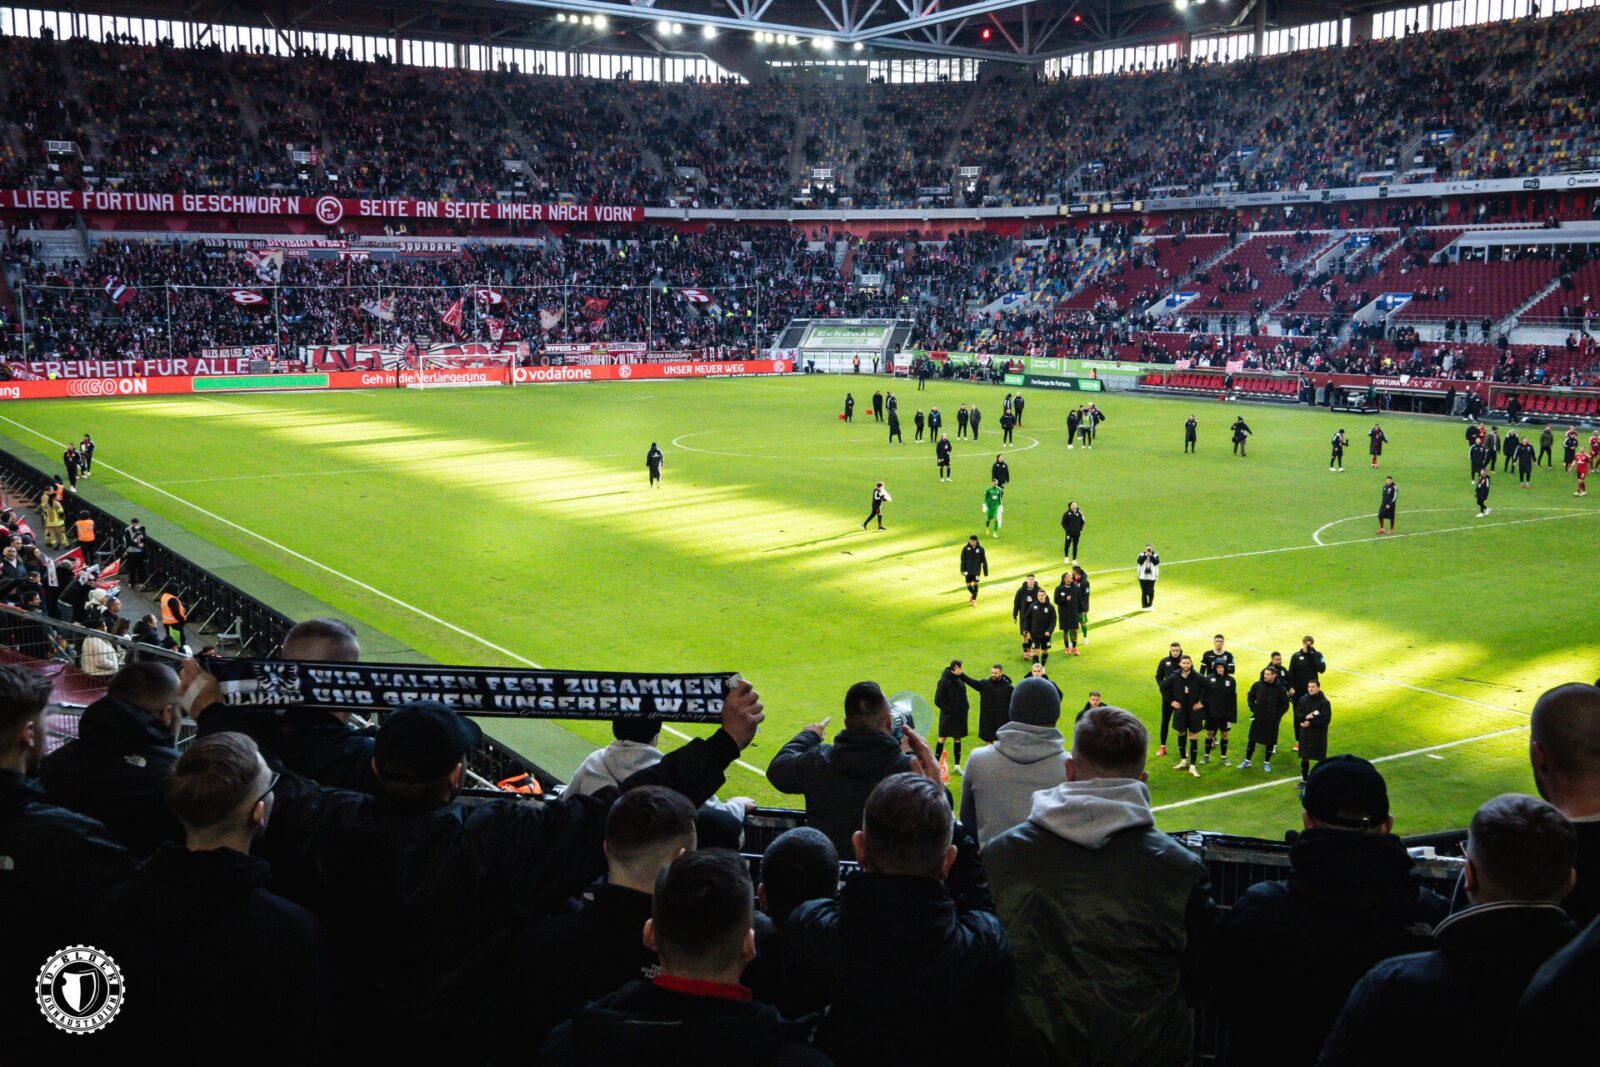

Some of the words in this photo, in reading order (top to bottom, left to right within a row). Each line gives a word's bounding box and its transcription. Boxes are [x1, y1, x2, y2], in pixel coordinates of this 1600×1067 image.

[12, 190, 73, 209] LIEBE
[83, 192, 174, 211] FORTUNA
[182, 195, 300, 214] GESCHWOR'N
[360, 200, 408, 216] SEITE
[417, 201, 438, 217] AN
[445, 201, 489, 219] SEITE
[498, 203, 542, 220] IMMER
[549, 205, 588, 221] NACH
[267, 239, 315, 248] DIVISION
[400, 241, 452, 252] SQUADRA
[202, 348, 219, 358] ALLES
[220, 348, 230, 358] AUS
[231, 348, 243, 358] LIEB
[30, 361, 136, 378] FREIHEIT
[145, 358, 188, 376] FÜR
[194, 358, 249, 375] ALLE
[528, 365, 592, 380] vodafone
[663, 365, 693, 375] UNSER
[695, 364, 723, 374] NEUER
[724, 363, 745, 373] WEG
[361, 374, 384, 385] Geh
[386, 373, 397, 384] in
[398, 373, 415, 384] die
[416, 371, 487, 384] Verlängerung
[1372, 378, 1400, 386] FORTUNA
[119, 378, 147, 394] ON
[308, 668, 365, 685] WIR
[370, 672, 479, 690] HALTEN
[486, 676, 554, 692] FEST
[564, 678, 722, 695] ZUSAMMEN
[312, 688, 374, 704] UND
[494, 695, 642, 711] UNSEREN
[654, 698, 725, 714] WEG
